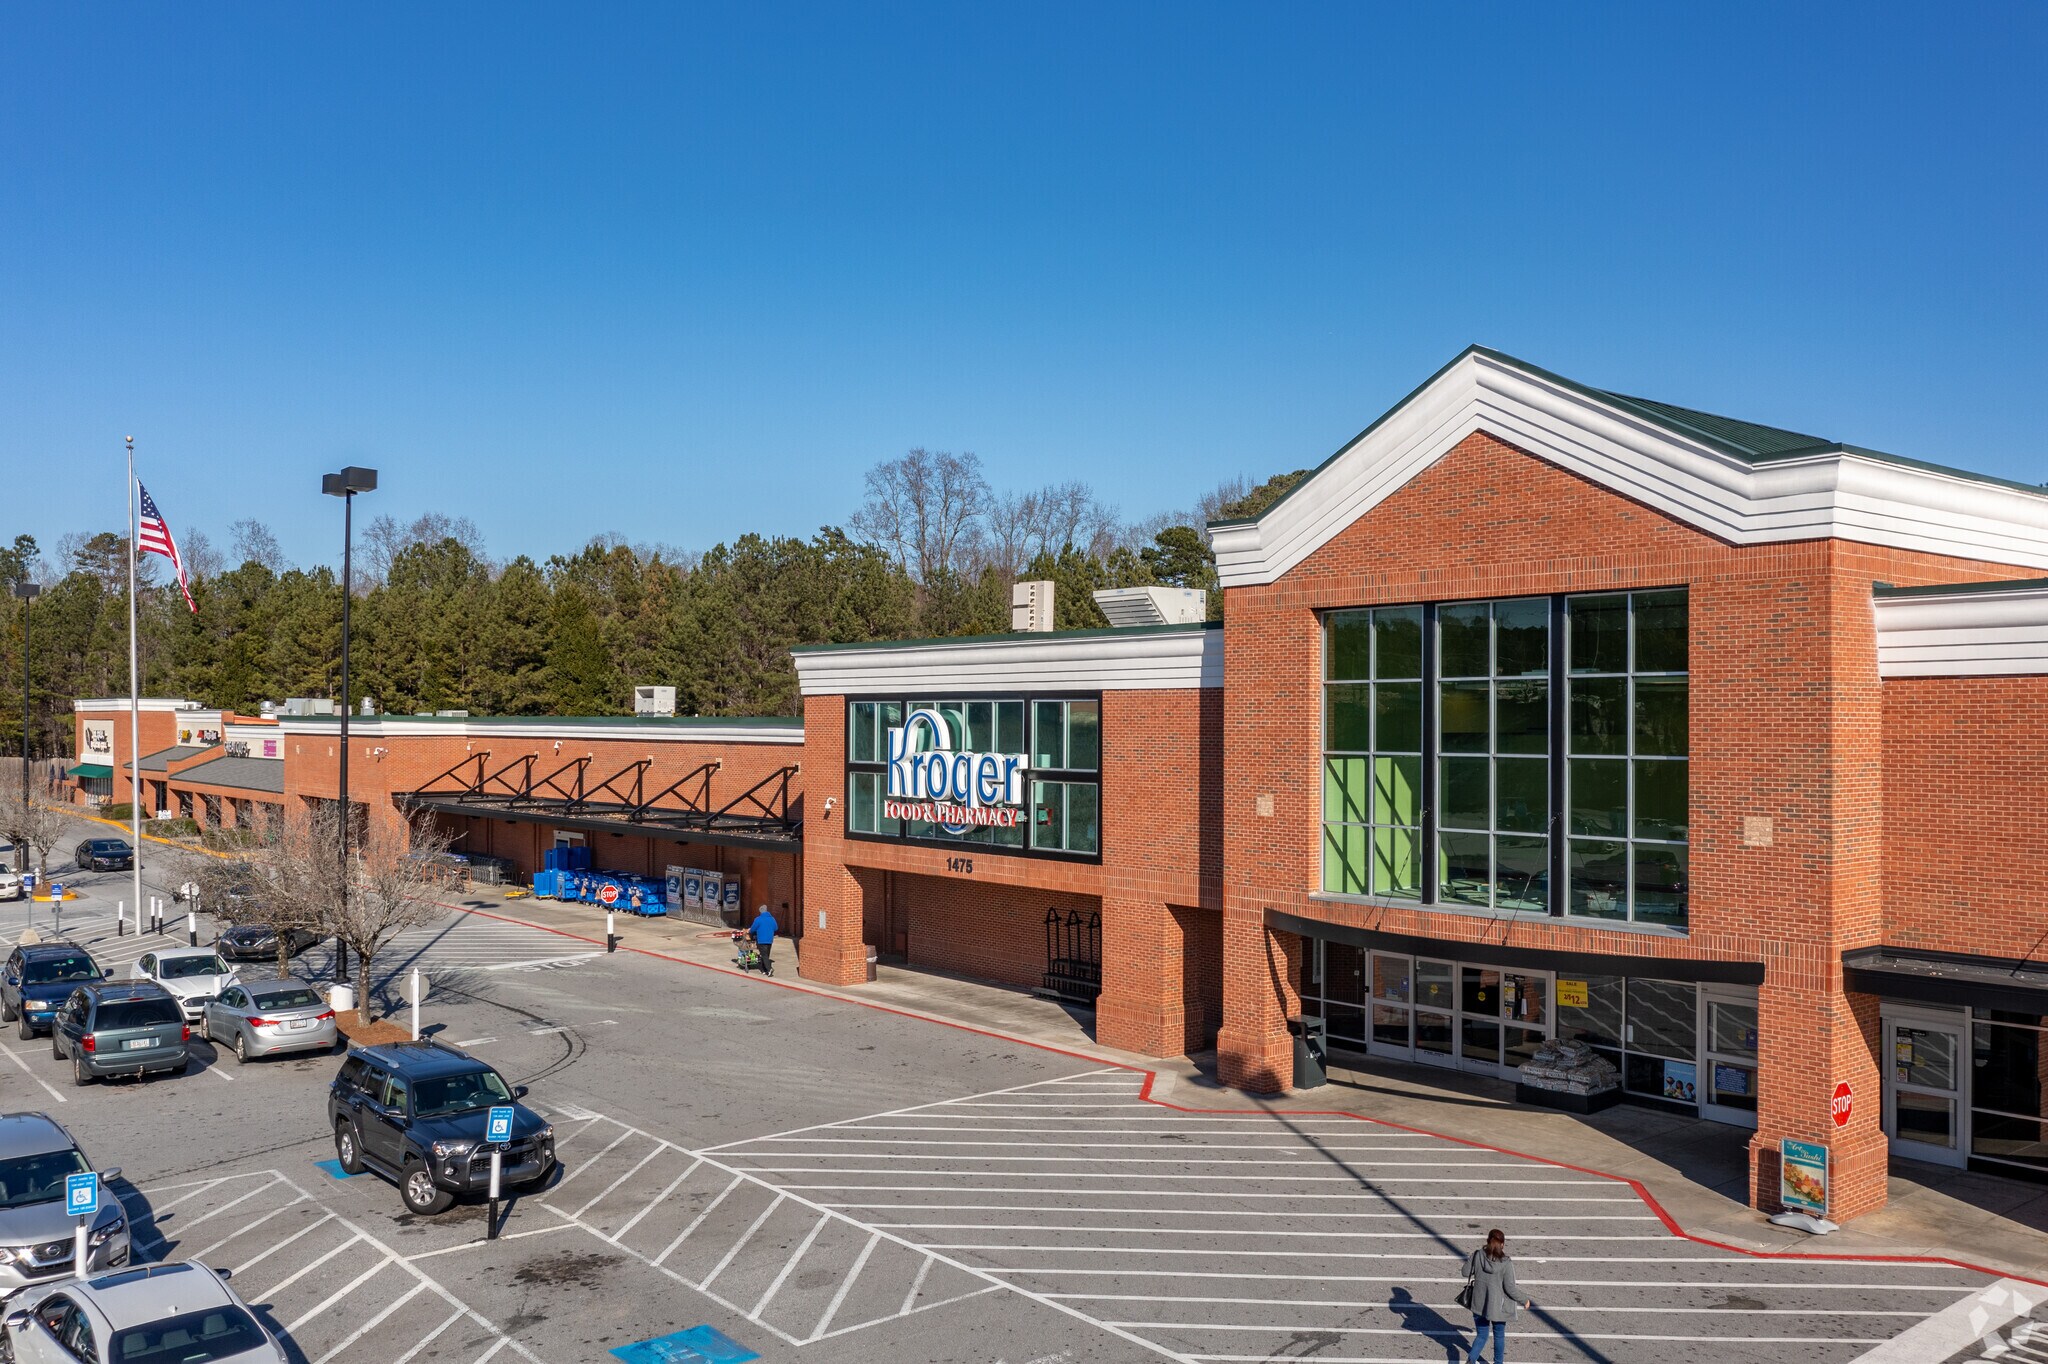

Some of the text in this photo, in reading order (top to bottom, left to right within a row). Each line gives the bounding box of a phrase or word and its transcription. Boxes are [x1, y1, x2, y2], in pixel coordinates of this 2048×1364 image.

[887, 708, 1028, 835] Kroger
[884, 800, 922, 821] FOOD
[937, 803, 1018, 828] PHARMACY
[946, 857, 973, 874] 1475
[513, 959, 591, 972] STOP
[1832, 1095, 1852, 1115] STOP
